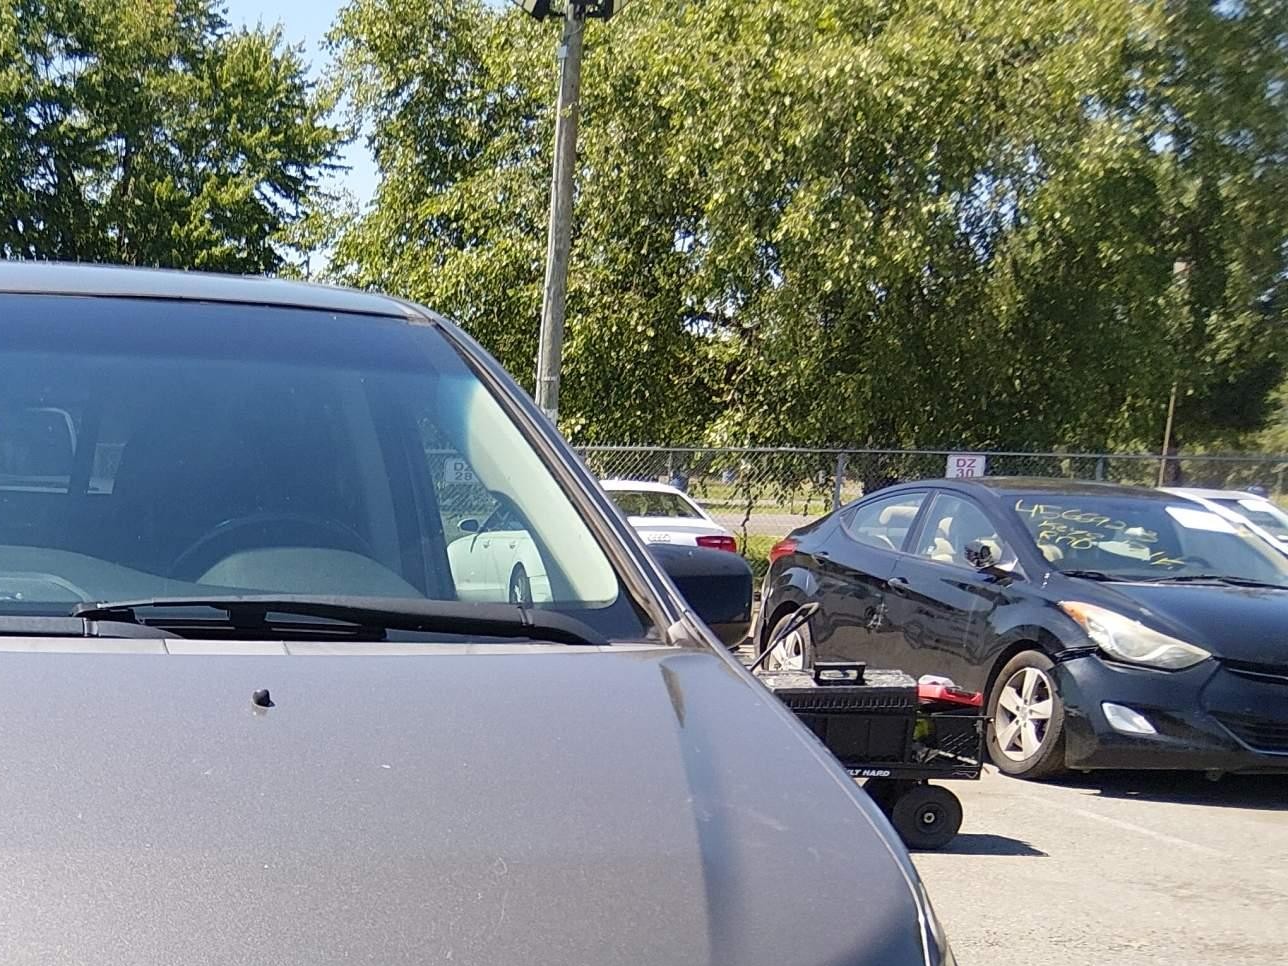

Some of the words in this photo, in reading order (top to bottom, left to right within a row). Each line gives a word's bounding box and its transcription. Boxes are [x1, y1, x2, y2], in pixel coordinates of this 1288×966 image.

[956, 458, 977, 468] DZ
[455, 471, 473, 481] 28
[862, 769, 891, 777] HARD
